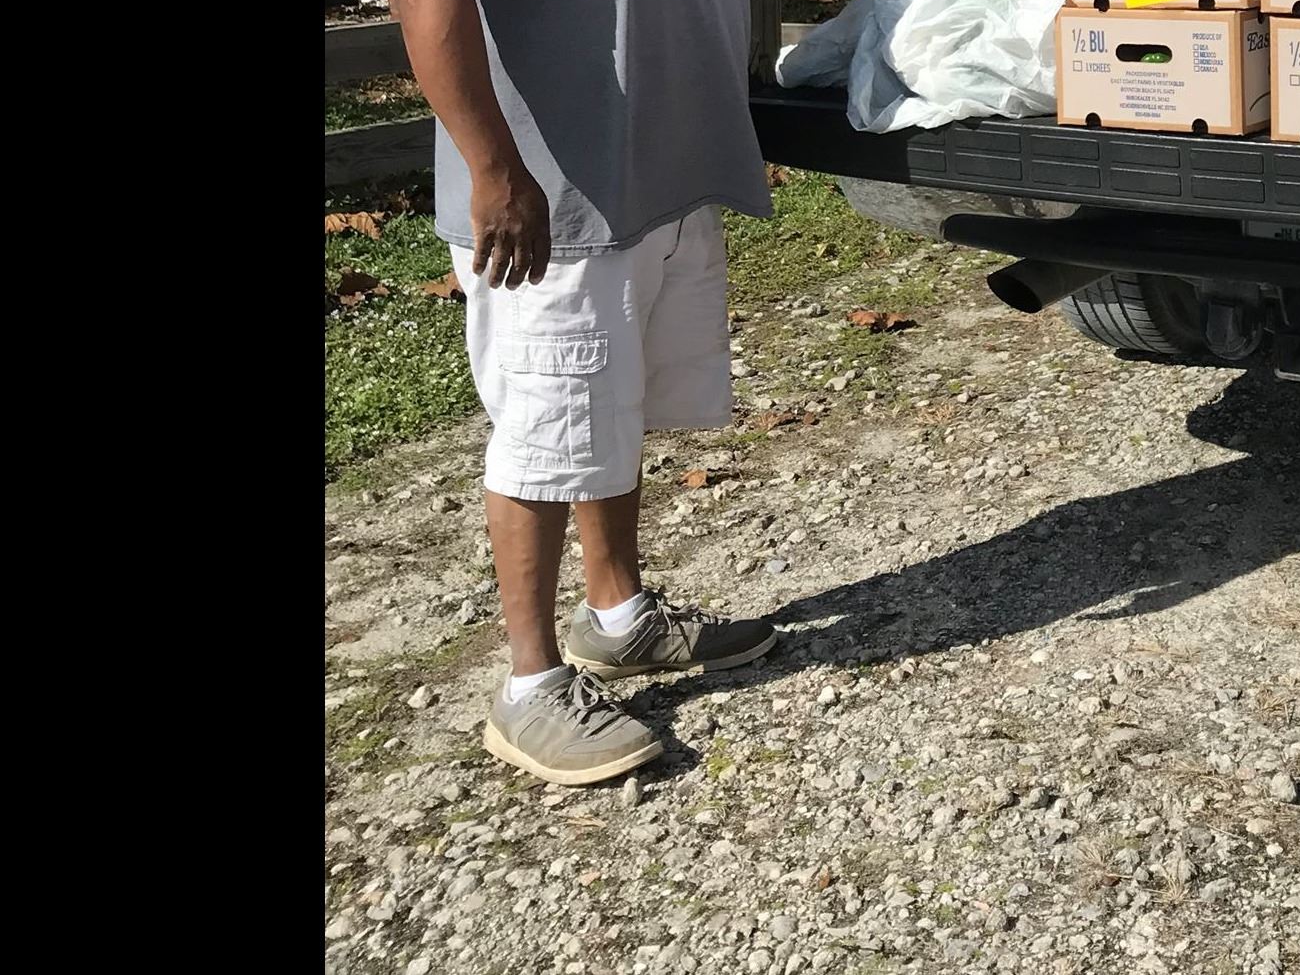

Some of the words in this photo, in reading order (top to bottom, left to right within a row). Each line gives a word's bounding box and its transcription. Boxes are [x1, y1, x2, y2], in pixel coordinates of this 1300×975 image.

[1192, 32, 1215, 40] PRODUCE
[1089, 30, 1108, 53] BU.
[1086, 63, 1111, 73] LYCHEES
[1200, 65, 1218, 73] CANADA
[1281, 228, 1292, 241] IN
